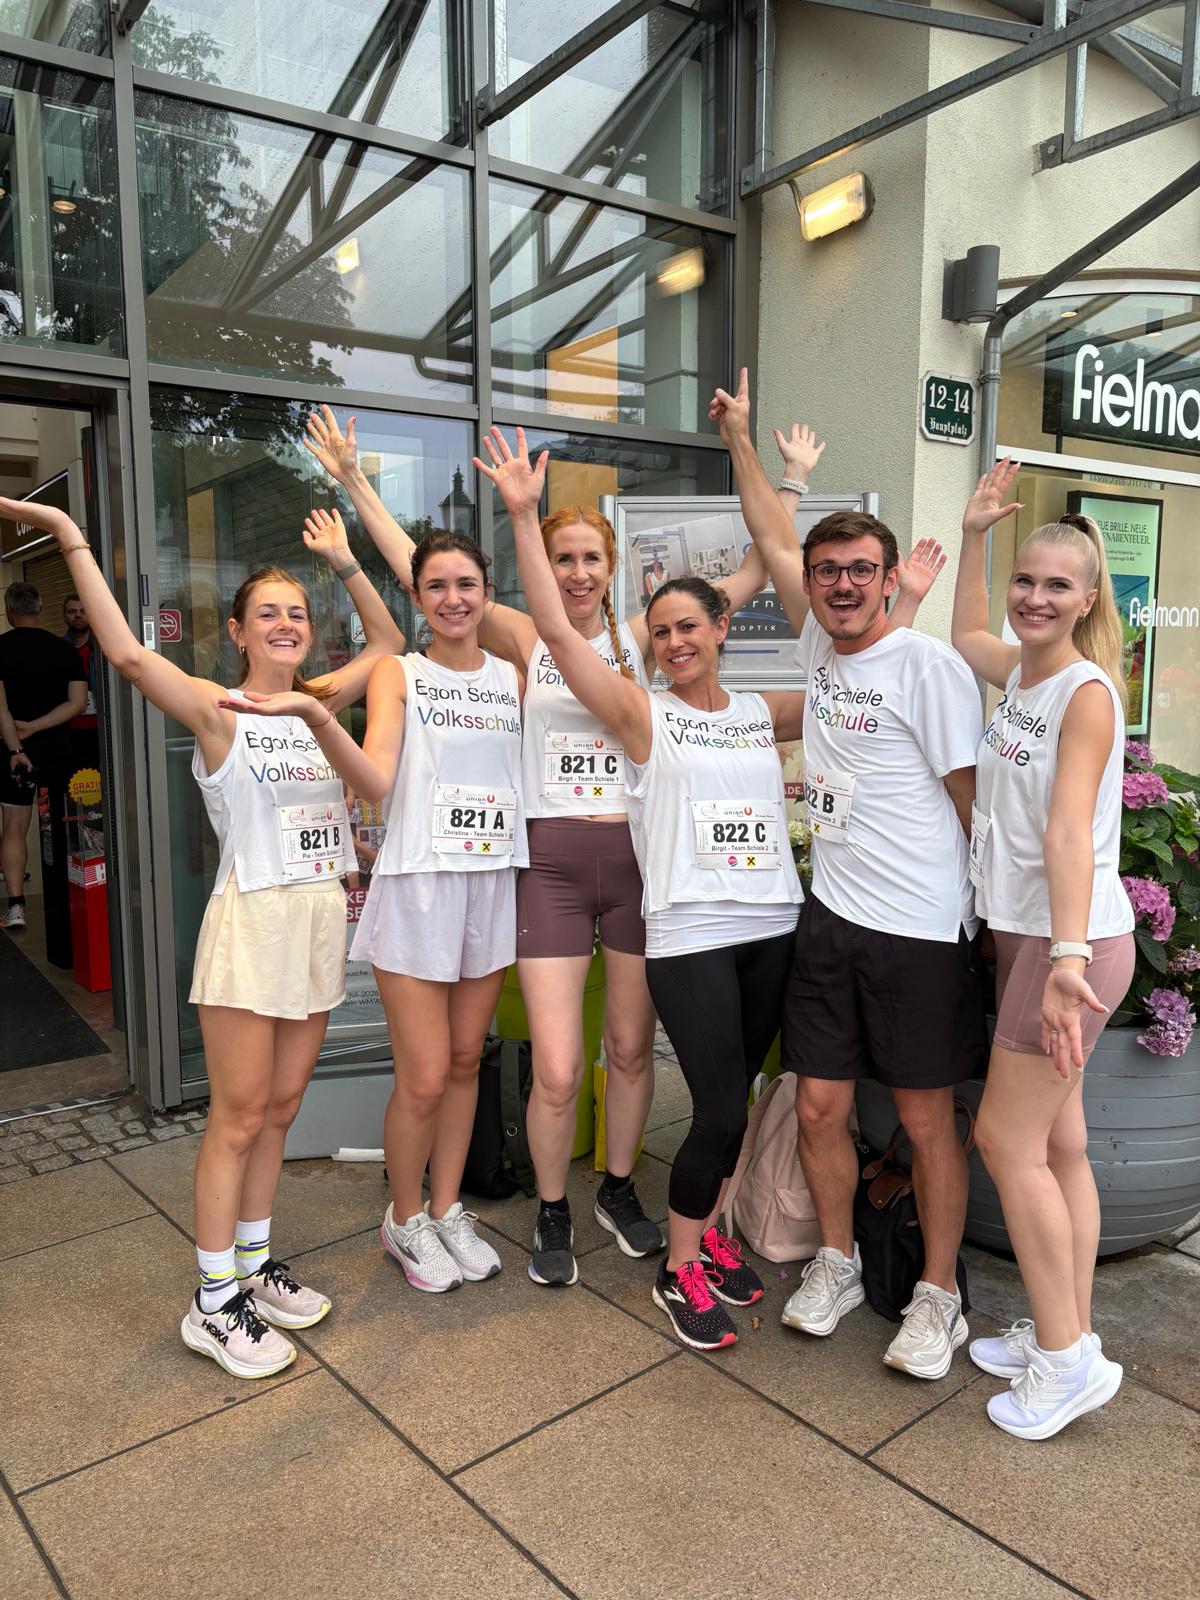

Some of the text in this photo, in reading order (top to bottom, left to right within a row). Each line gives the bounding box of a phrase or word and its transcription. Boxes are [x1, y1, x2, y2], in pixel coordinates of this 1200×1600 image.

[929, 383, 970, 414] 12-14
[929, 416, 967, 439] Hauptplatz
[1131, 523, 1148, 534] NEUE
[1130, 597, 1198, 627] fielmann
[415, 679, 518, 708] Egon Schiele
[417, 706, 520, 736] Volksschule
[560, 755, 595, 774] 821
[604, 755, 617, 774] C
[822, 792, 834, 814] B
[450, 808, 486, 829] 821
[493, 810, 504, 830] A
[300, 828, 328, 851] 821
[333, 826, 340, 846] B
[713, 823, 750, 842] 822
[755, 822, 766, 842] C
[202, 1318, 229, 1347] HOKA
